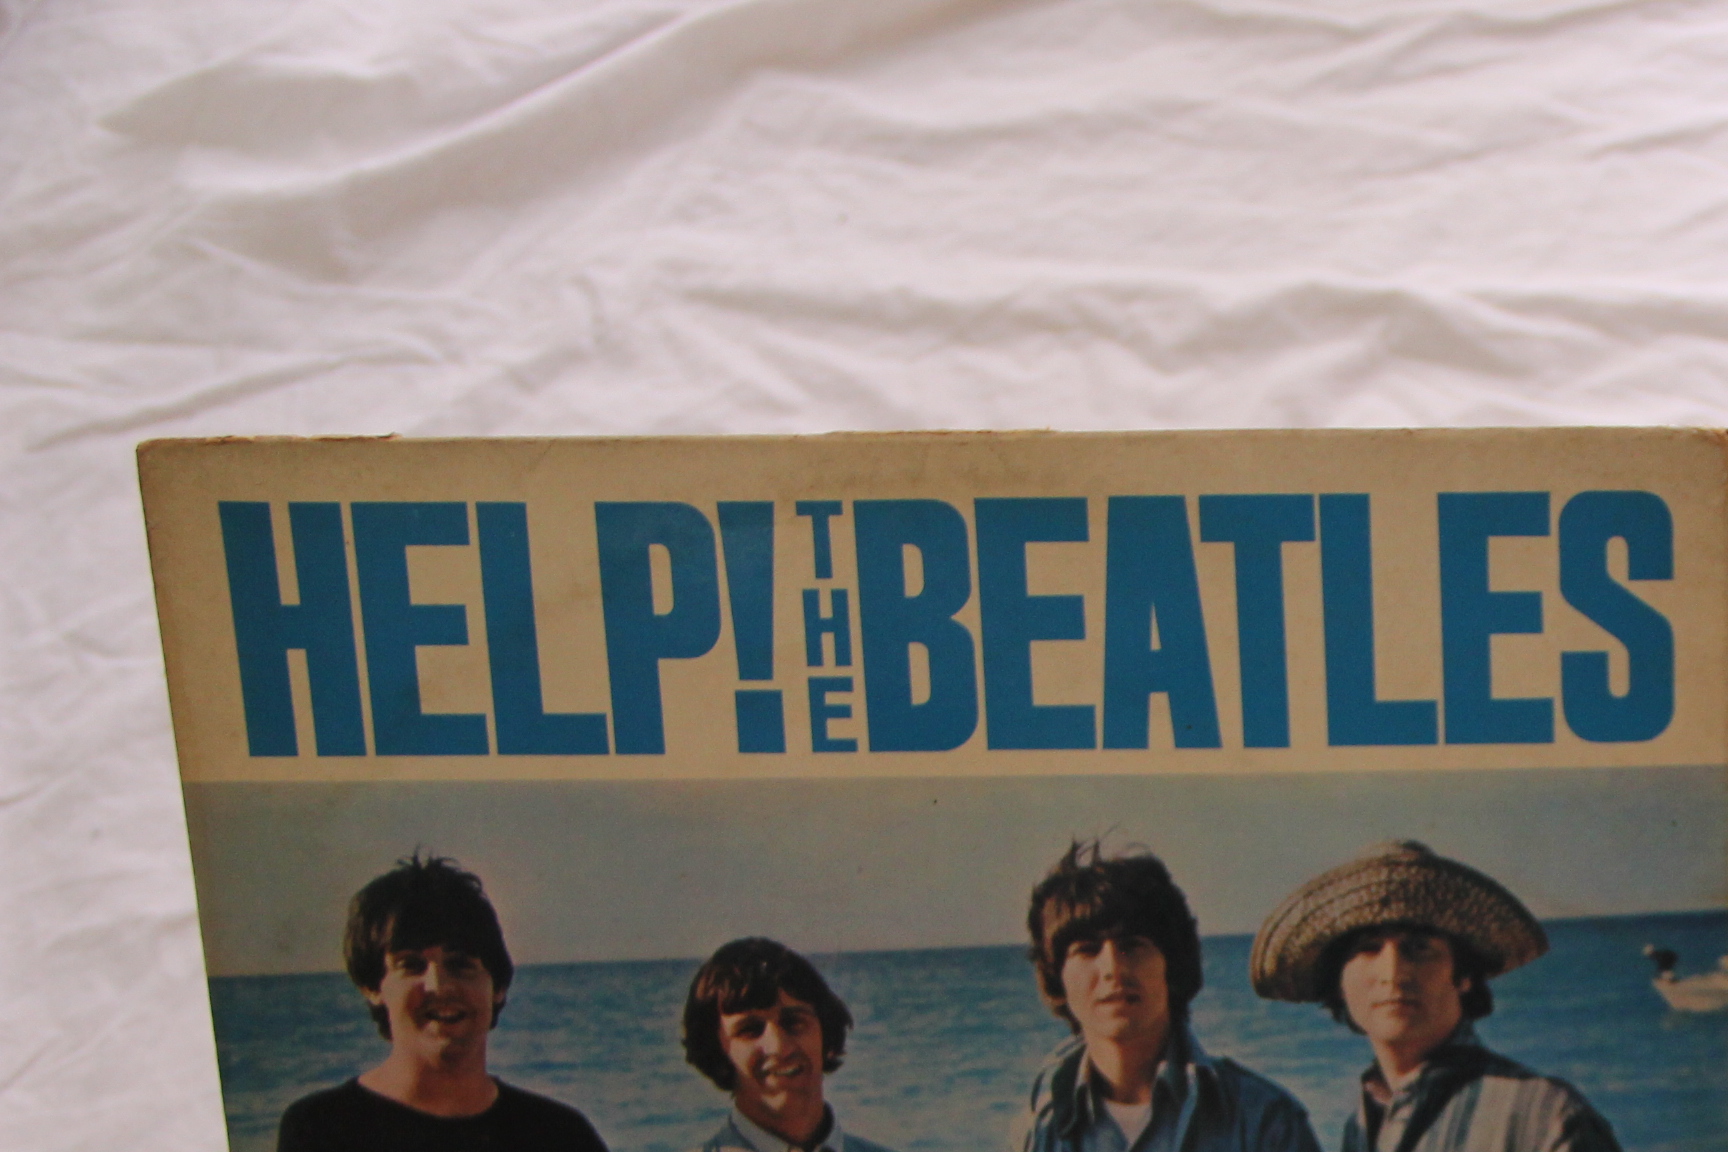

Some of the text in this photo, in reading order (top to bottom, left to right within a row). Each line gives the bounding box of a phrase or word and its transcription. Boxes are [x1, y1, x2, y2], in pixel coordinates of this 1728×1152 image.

[217, 489, 1675, 758] HELP! THE BEATLES
